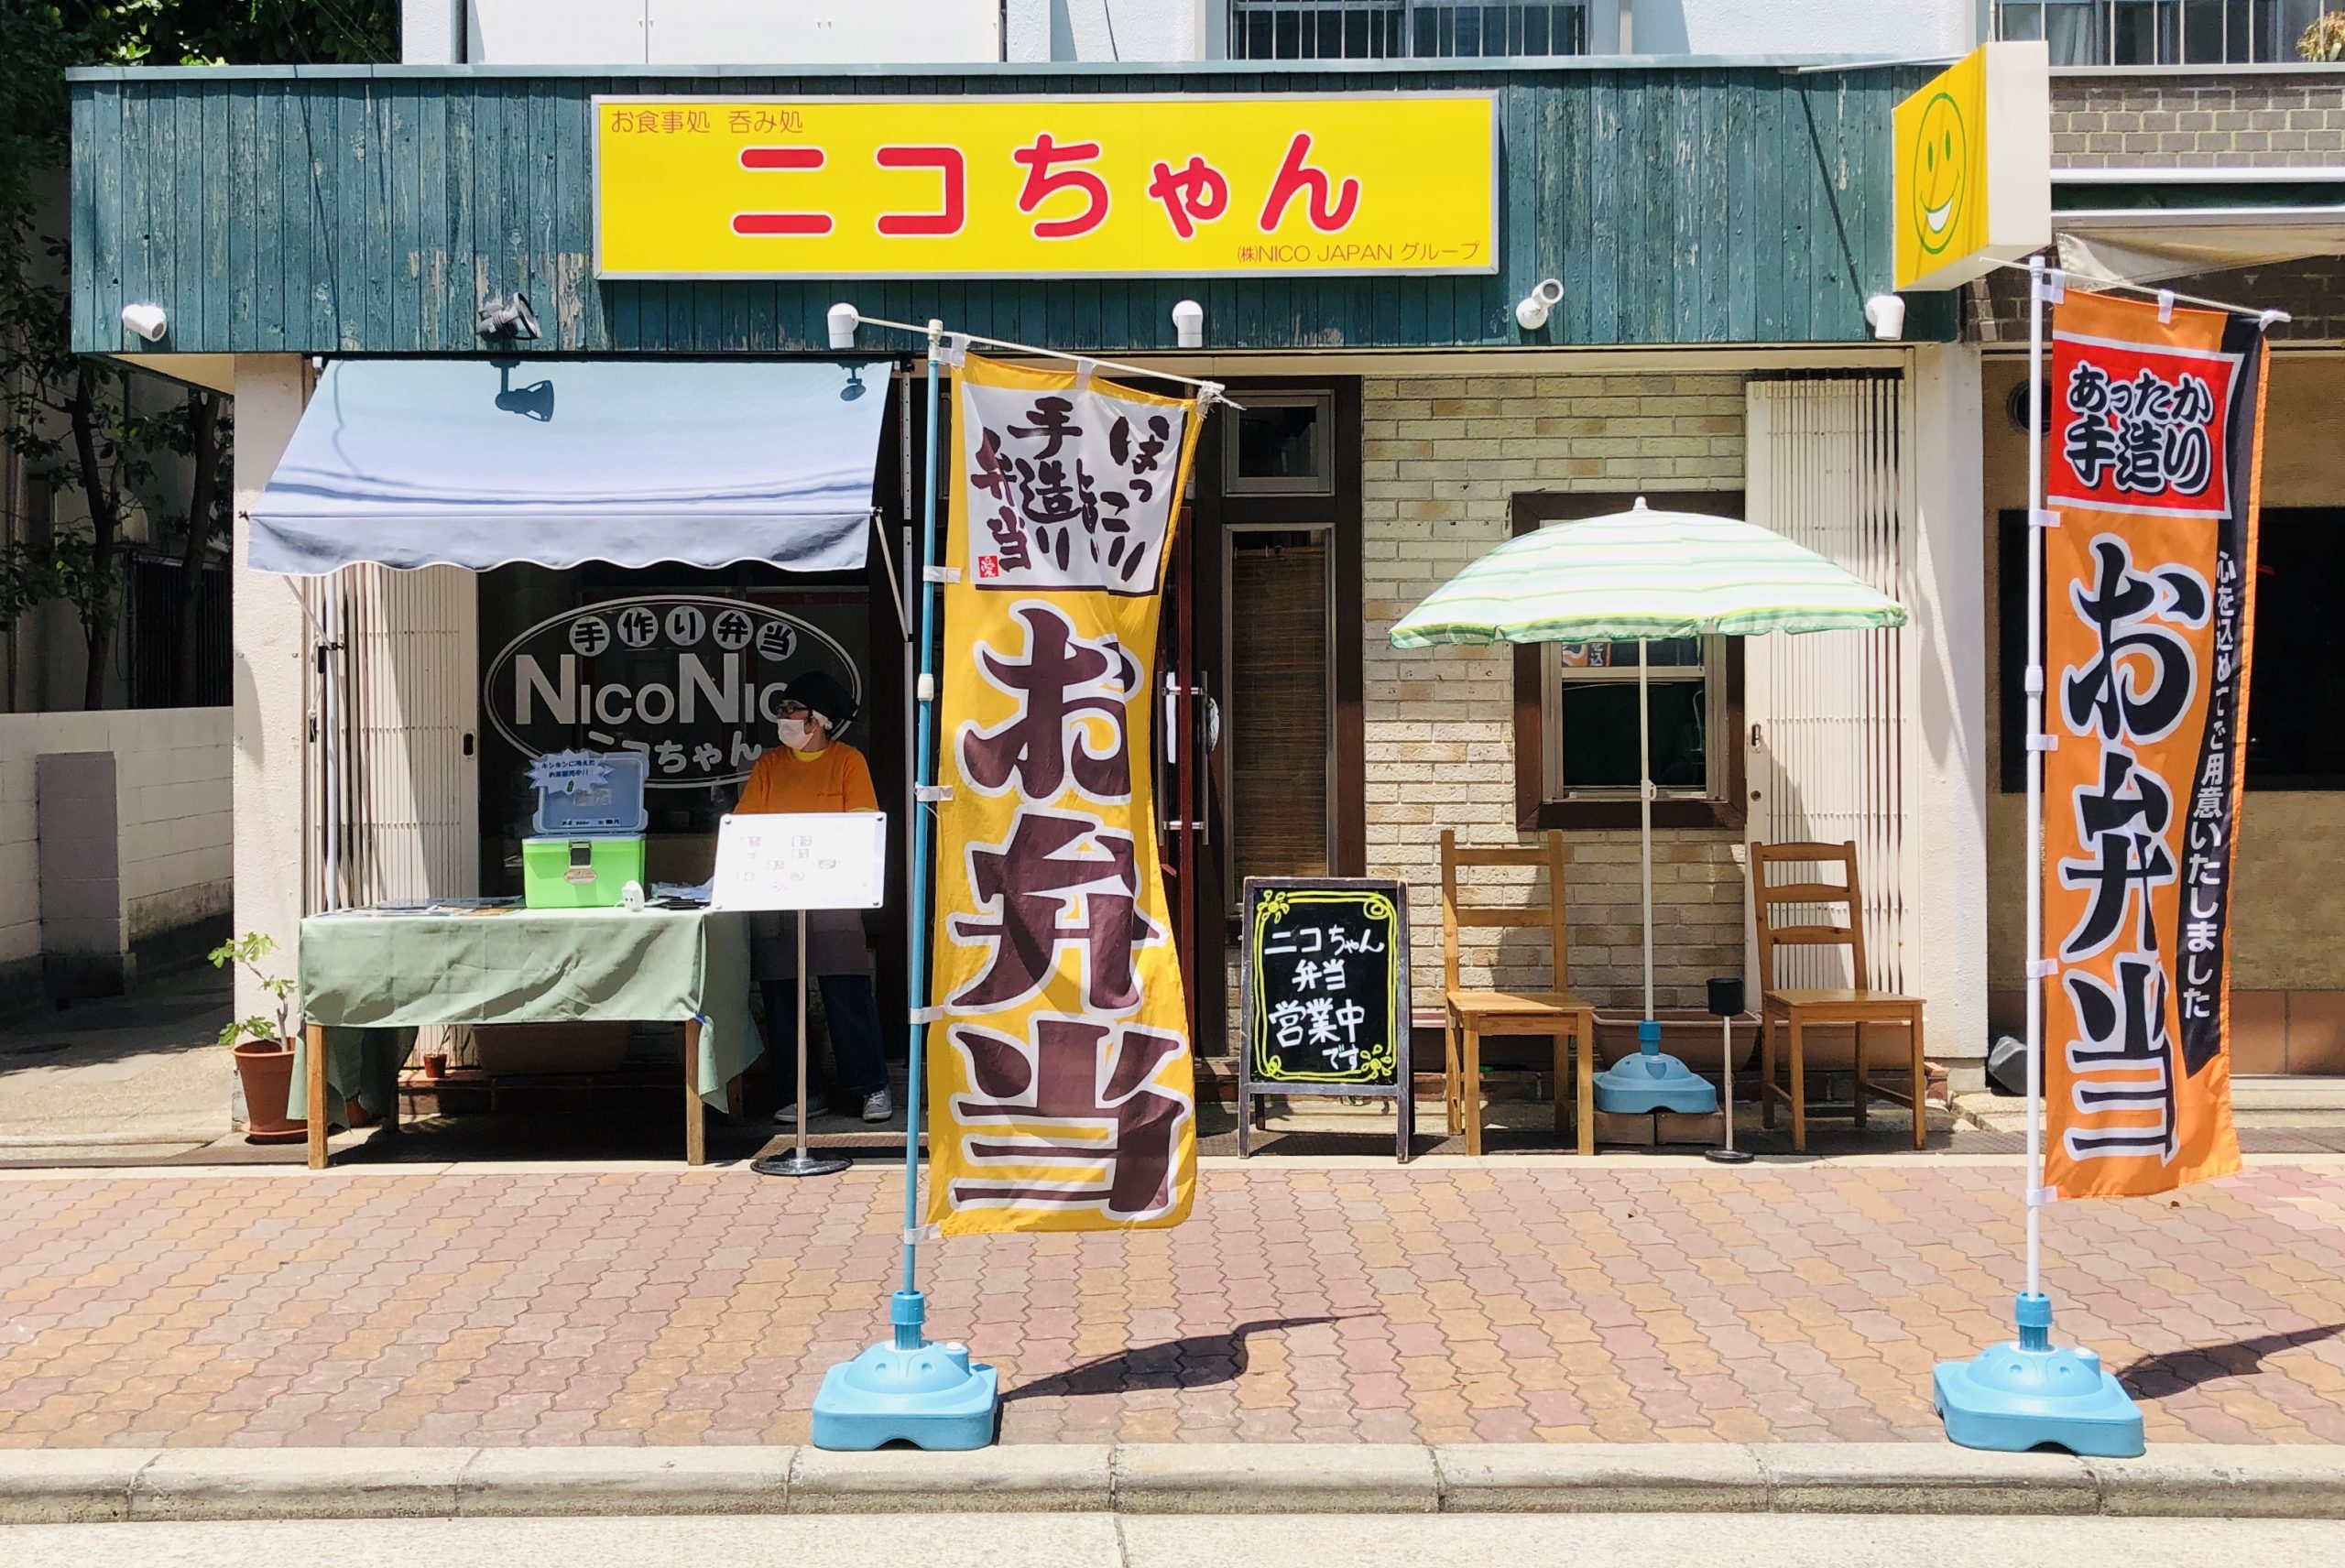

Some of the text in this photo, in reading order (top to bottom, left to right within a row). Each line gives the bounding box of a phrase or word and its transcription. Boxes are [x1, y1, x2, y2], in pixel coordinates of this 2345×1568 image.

[611, 110, 803, 134] お食事処 呑み処
[733, 134, 1358, 238] ニコちゃん
[1317, 243, 1392, 262] JAPAN
[1402, 241, 1480, 262] グループ
[2067, 360, 2214, 427] あったか
[2065, 414, 2213, 495] 手造り
[572, 607, 795, 659] 手作り弁当
[2059, 534, 2210, 1165] お弁当
[947, 600, 1191, 1218] お弁当
[1264, 924, 1385, 955] ニコちゃん
[1292, 958, 1347, 992] 弁当
[1268, 997, 1366, 1049] 営業中
[1322, 1043, 1359, 1071] です
